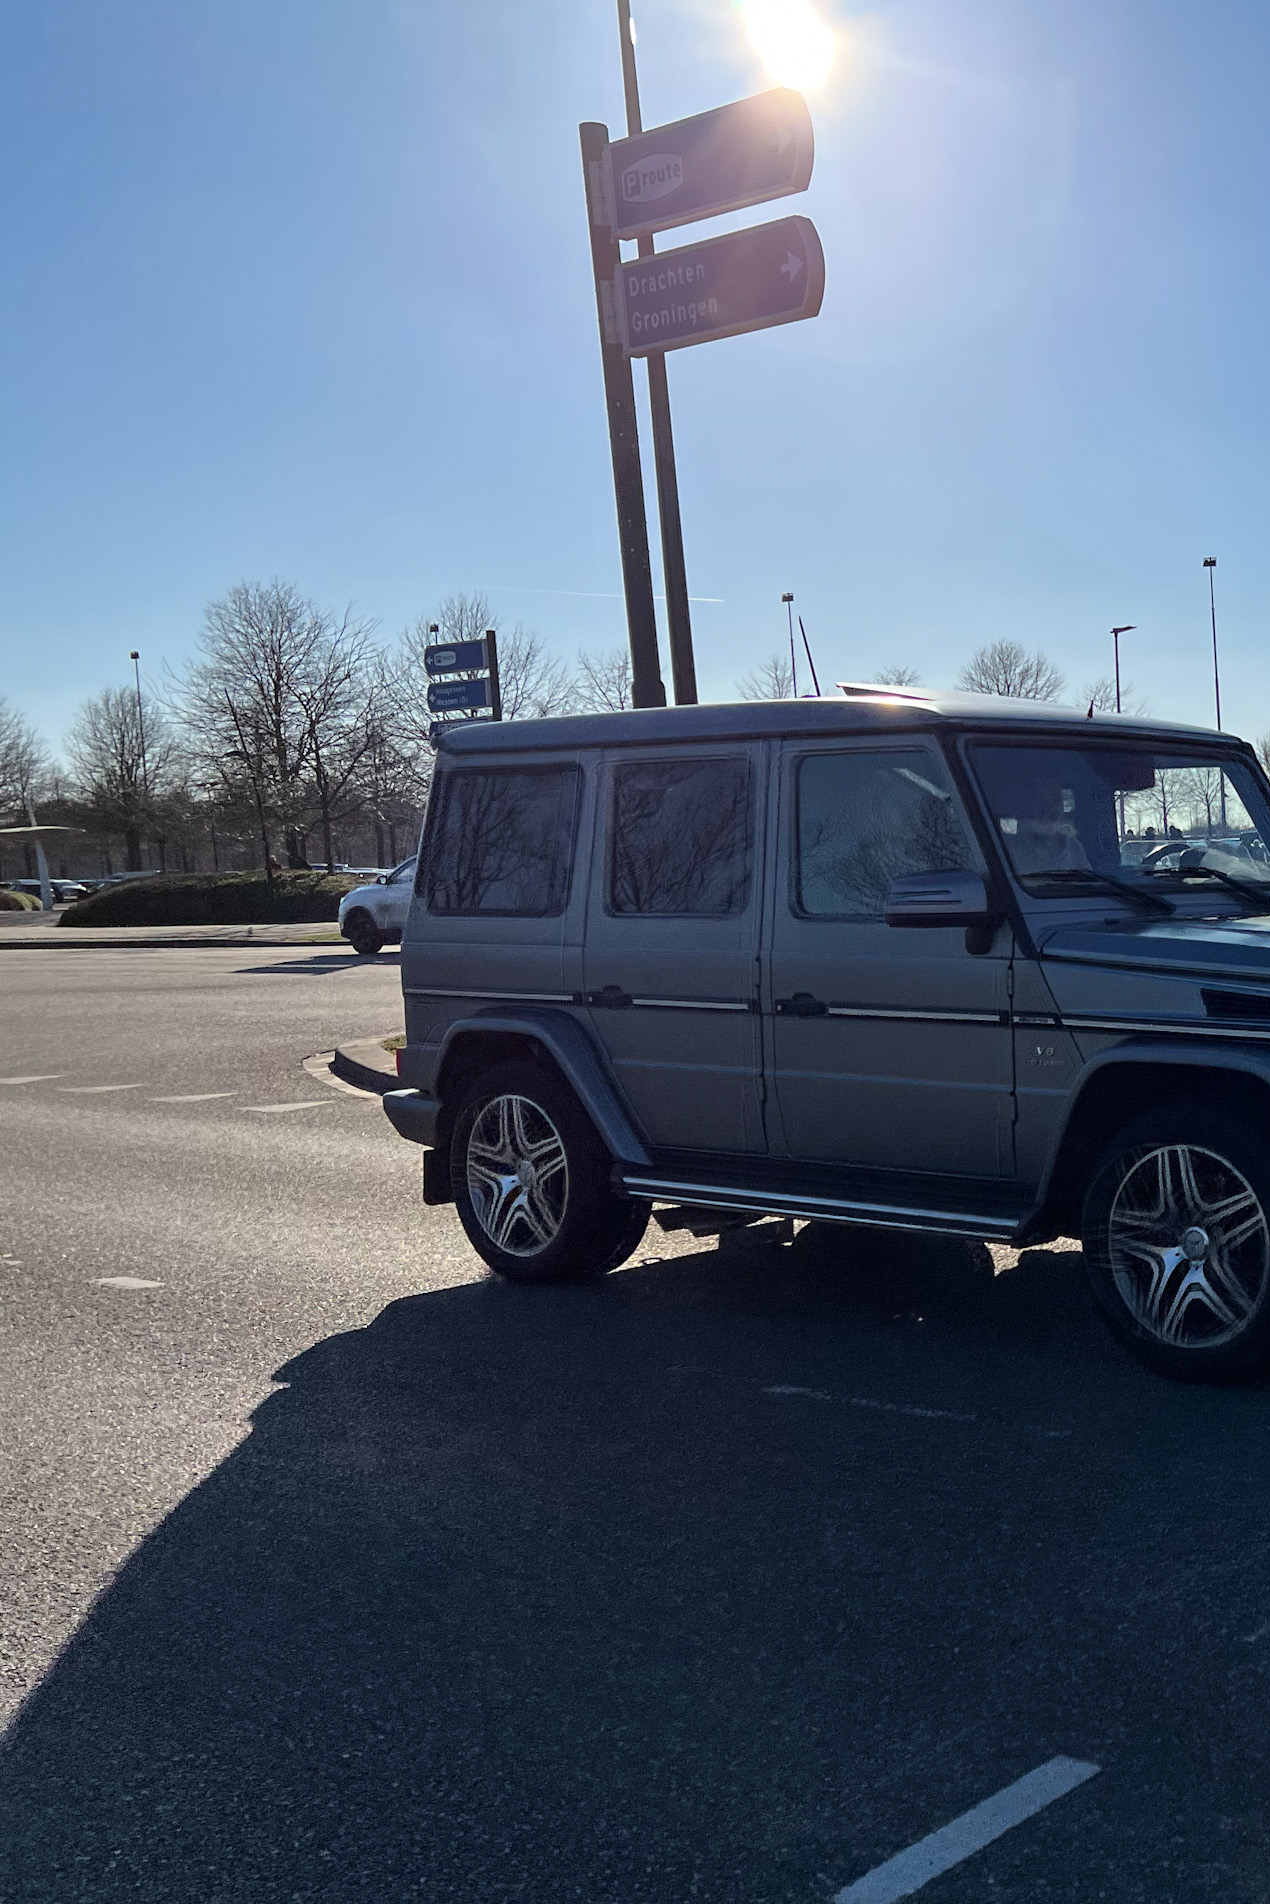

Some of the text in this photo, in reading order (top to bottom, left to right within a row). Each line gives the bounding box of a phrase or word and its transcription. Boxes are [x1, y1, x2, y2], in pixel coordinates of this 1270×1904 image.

[641, 161, 682, 187] route
[629, 263, 706, 298] Drachten
[632, 298, 718, 332] Groningen
